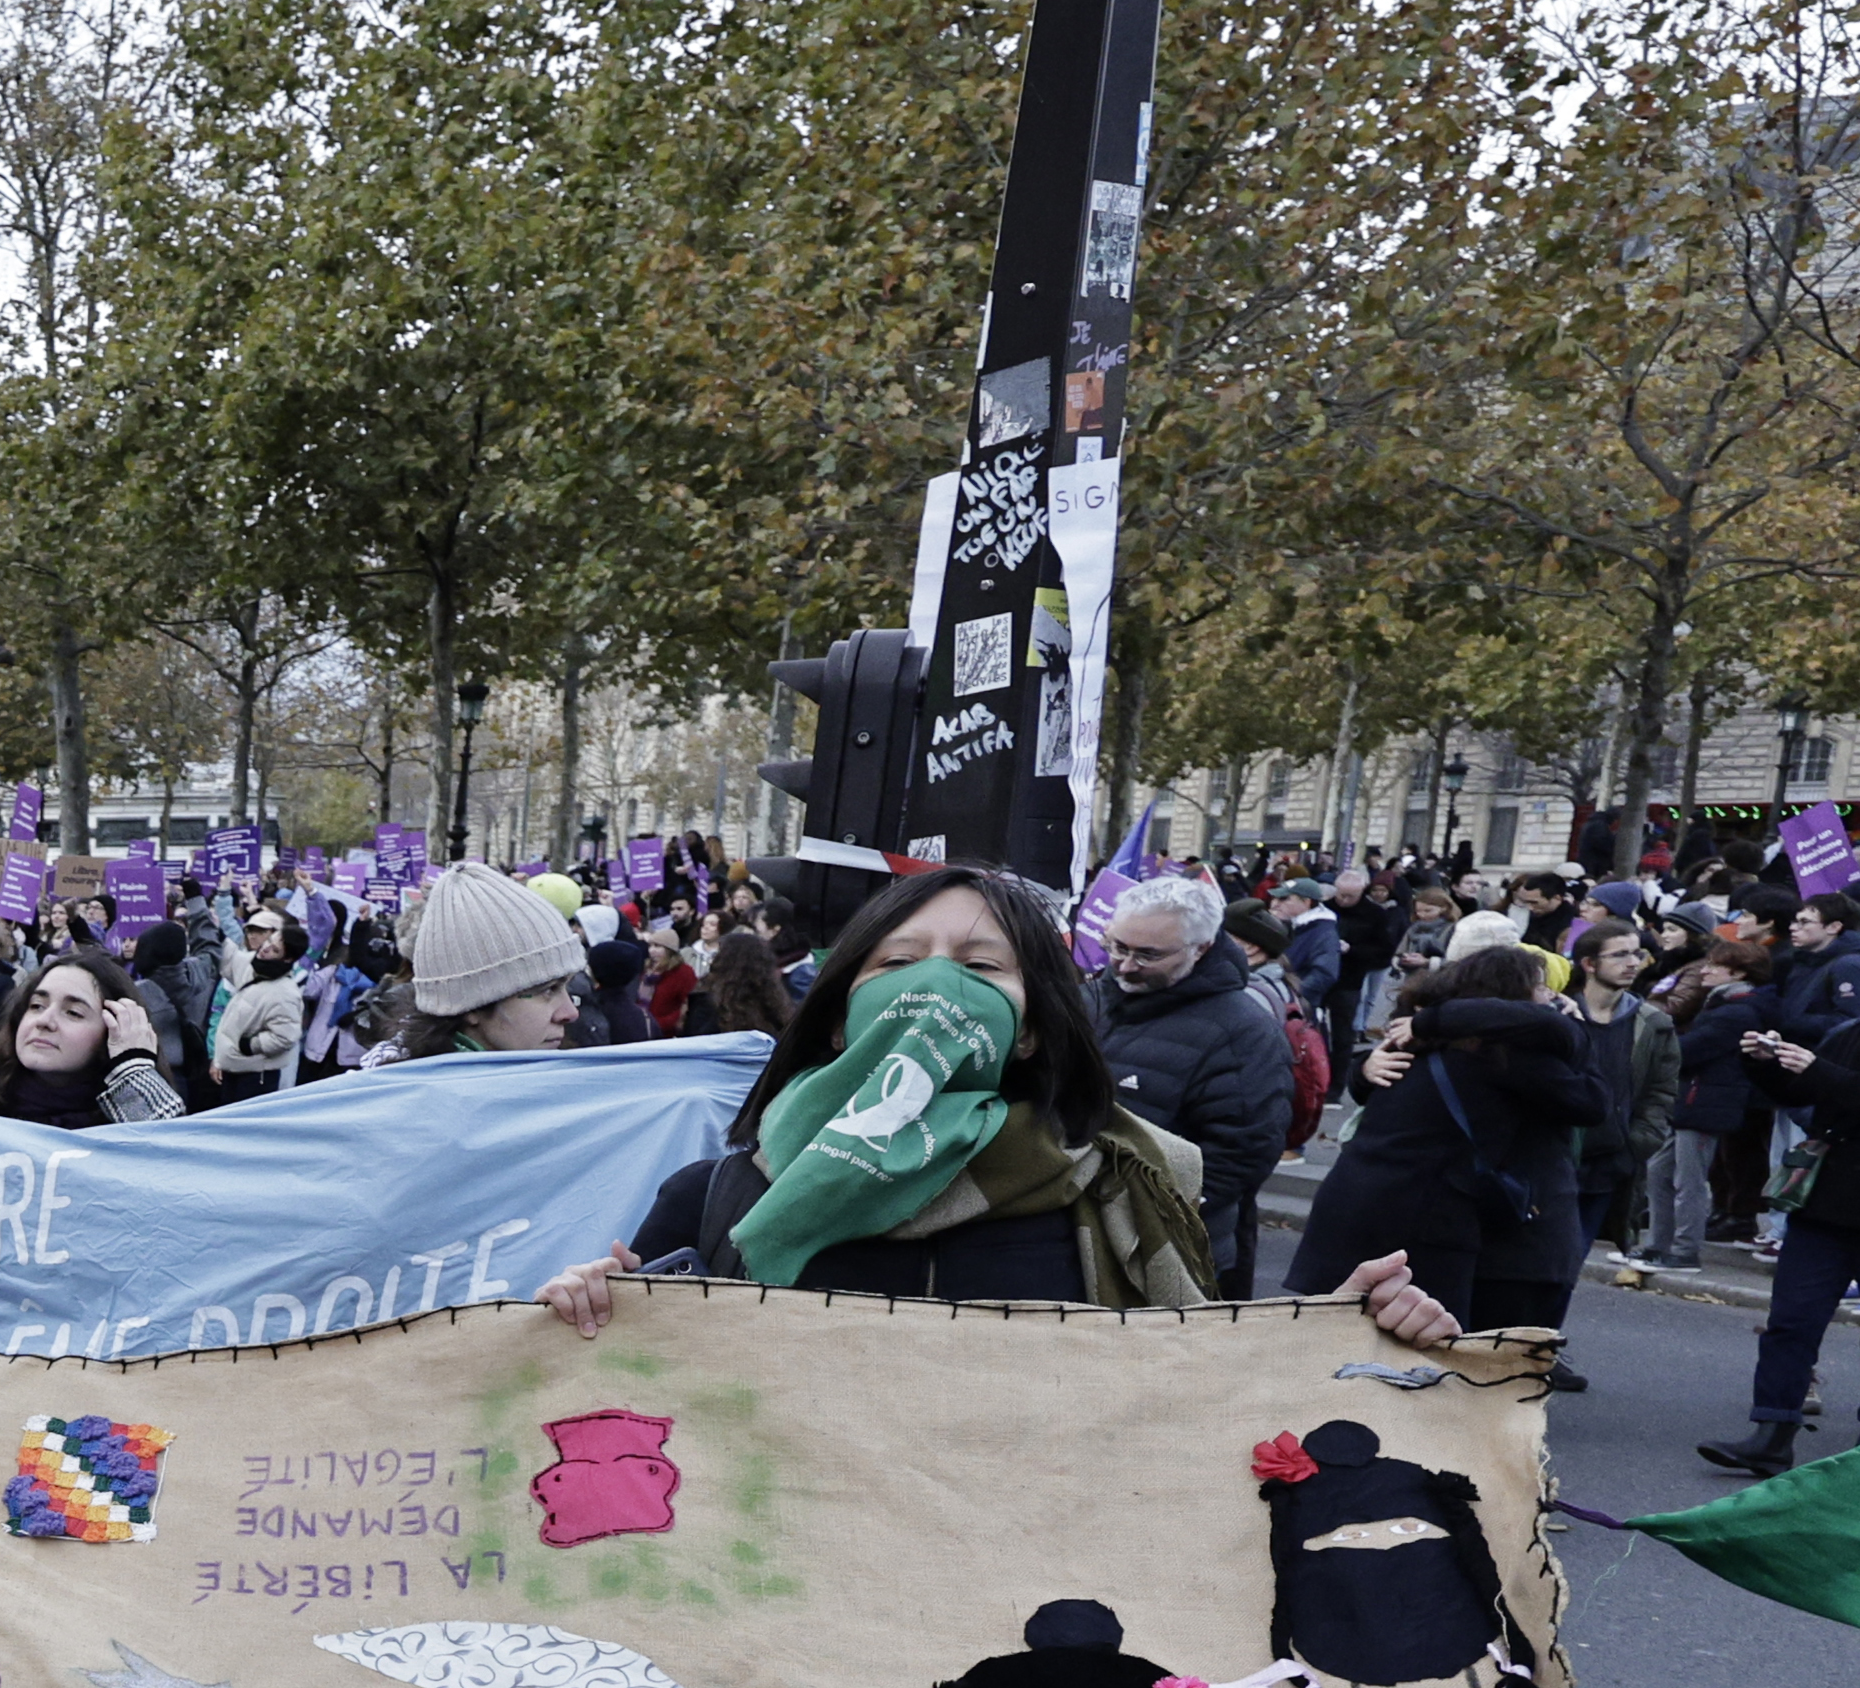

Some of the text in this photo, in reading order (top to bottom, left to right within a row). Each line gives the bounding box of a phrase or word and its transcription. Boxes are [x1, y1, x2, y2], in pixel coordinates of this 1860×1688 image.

[932, 702, 996, 746] ACAB
[926, 720, 1015, 784] ANTIFA
[901, 992, 951, 1010] Nacional
[951, 1005, 968, 1022] Por
[932, 1008, 959, 1037] Seguro
[233, 1504, 461, 1540] DEMANDE
[439, 1549, 507, 1591] LA
